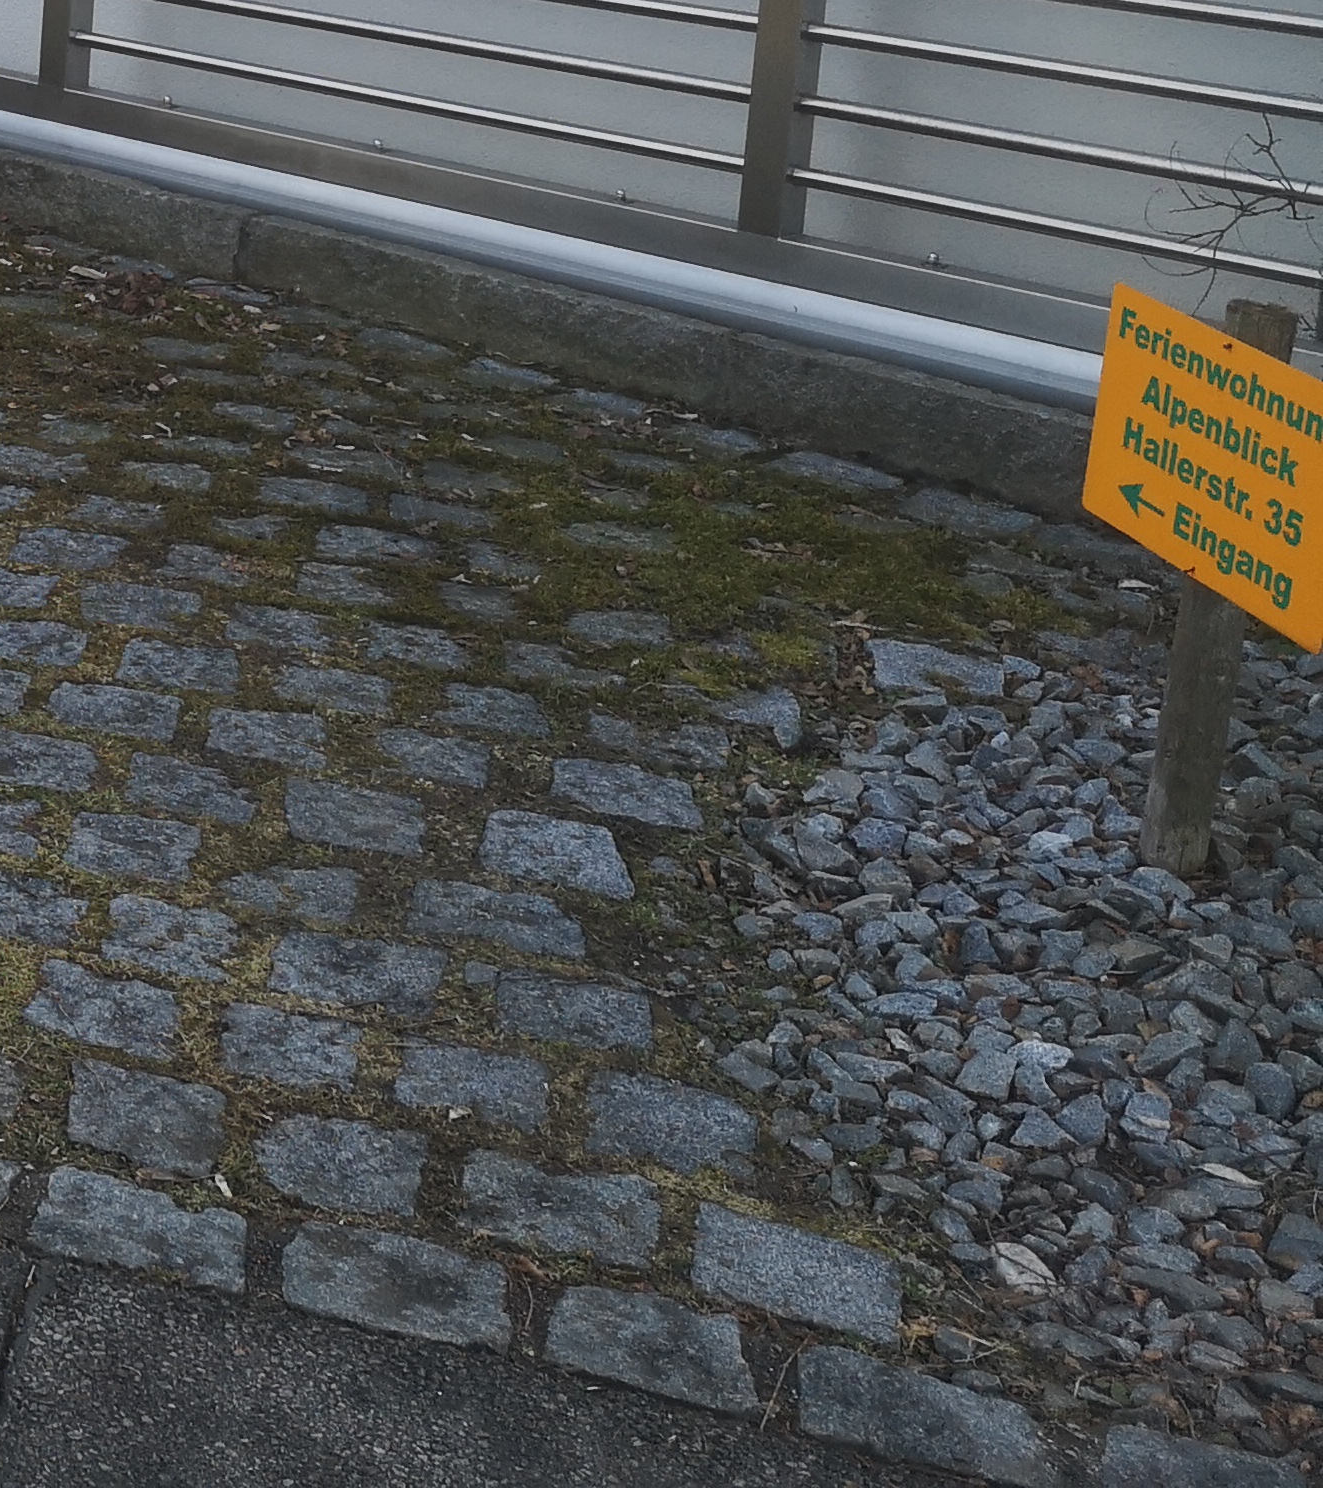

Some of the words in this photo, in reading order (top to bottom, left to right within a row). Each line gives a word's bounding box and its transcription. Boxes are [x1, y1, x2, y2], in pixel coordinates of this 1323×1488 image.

[1118, 306, 1323, 443] Ferienwohnun
[1141, 376, 1299, 487] Alpenblick
[1122, 417, 1253, 521] Hallerstr.
[1263, 498, 1304, 548] 35
[1172, 502, 1293, 611] Eingang
